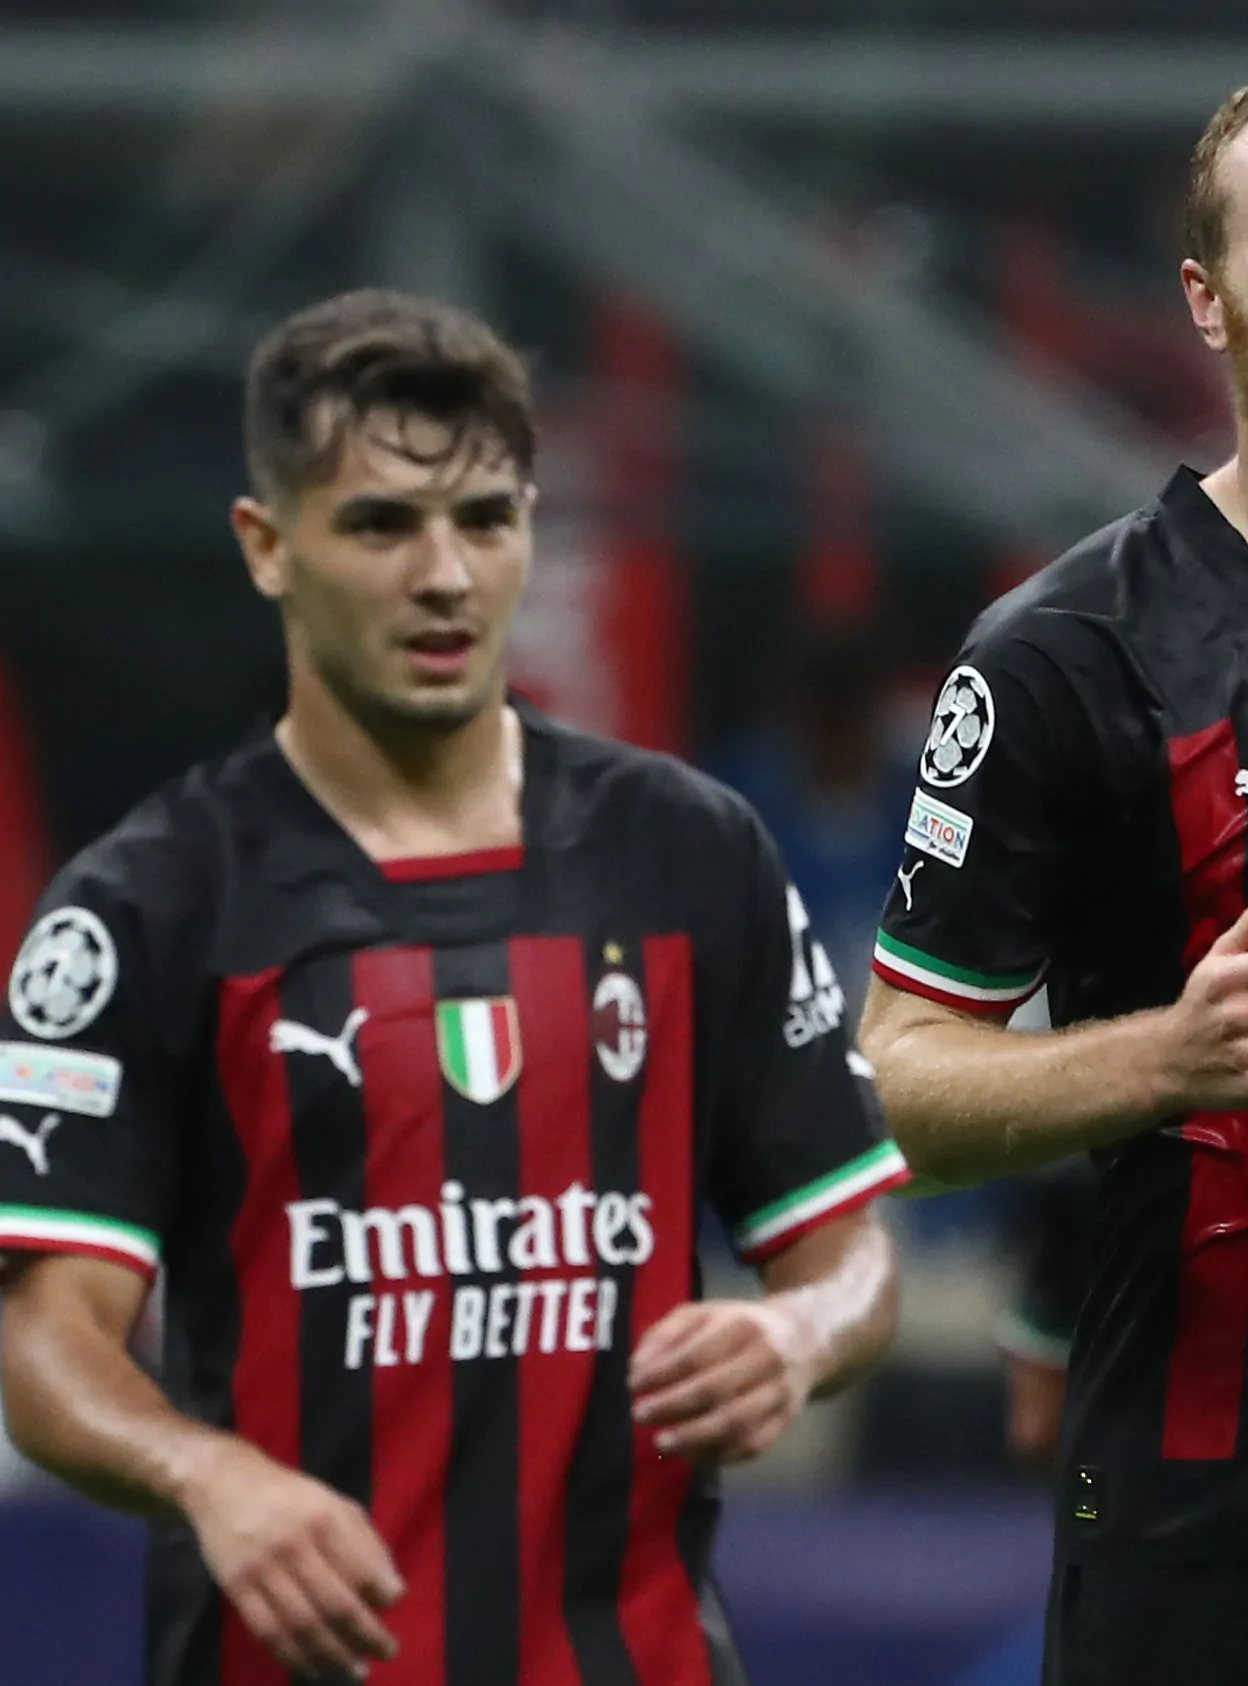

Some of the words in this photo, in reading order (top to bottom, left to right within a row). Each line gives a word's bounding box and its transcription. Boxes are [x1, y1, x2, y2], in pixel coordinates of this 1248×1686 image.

[285, 1178, 655, 1290] Emirates
[344, 1289, 434, 1370] FLY
[449, 1275, 618, 1361] BETTER
